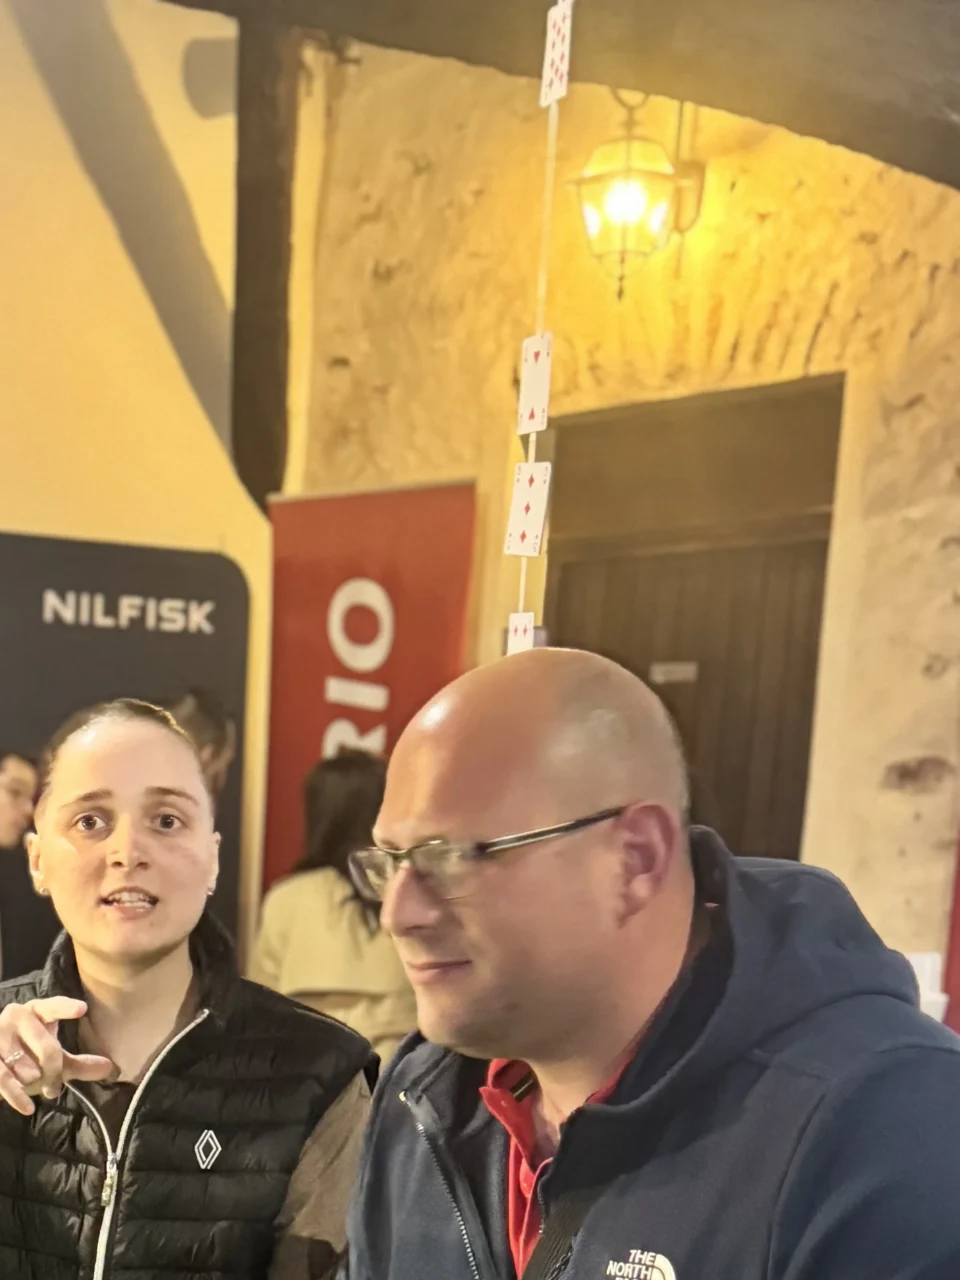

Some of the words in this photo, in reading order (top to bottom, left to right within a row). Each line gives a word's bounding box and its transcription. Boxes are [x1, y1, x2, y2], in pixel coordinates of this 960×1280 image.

[42, 588, 216, 635] NILFISK
[628, 1249, 656, 1265] THE
[606, 1260, 652, 1280] NORTH
